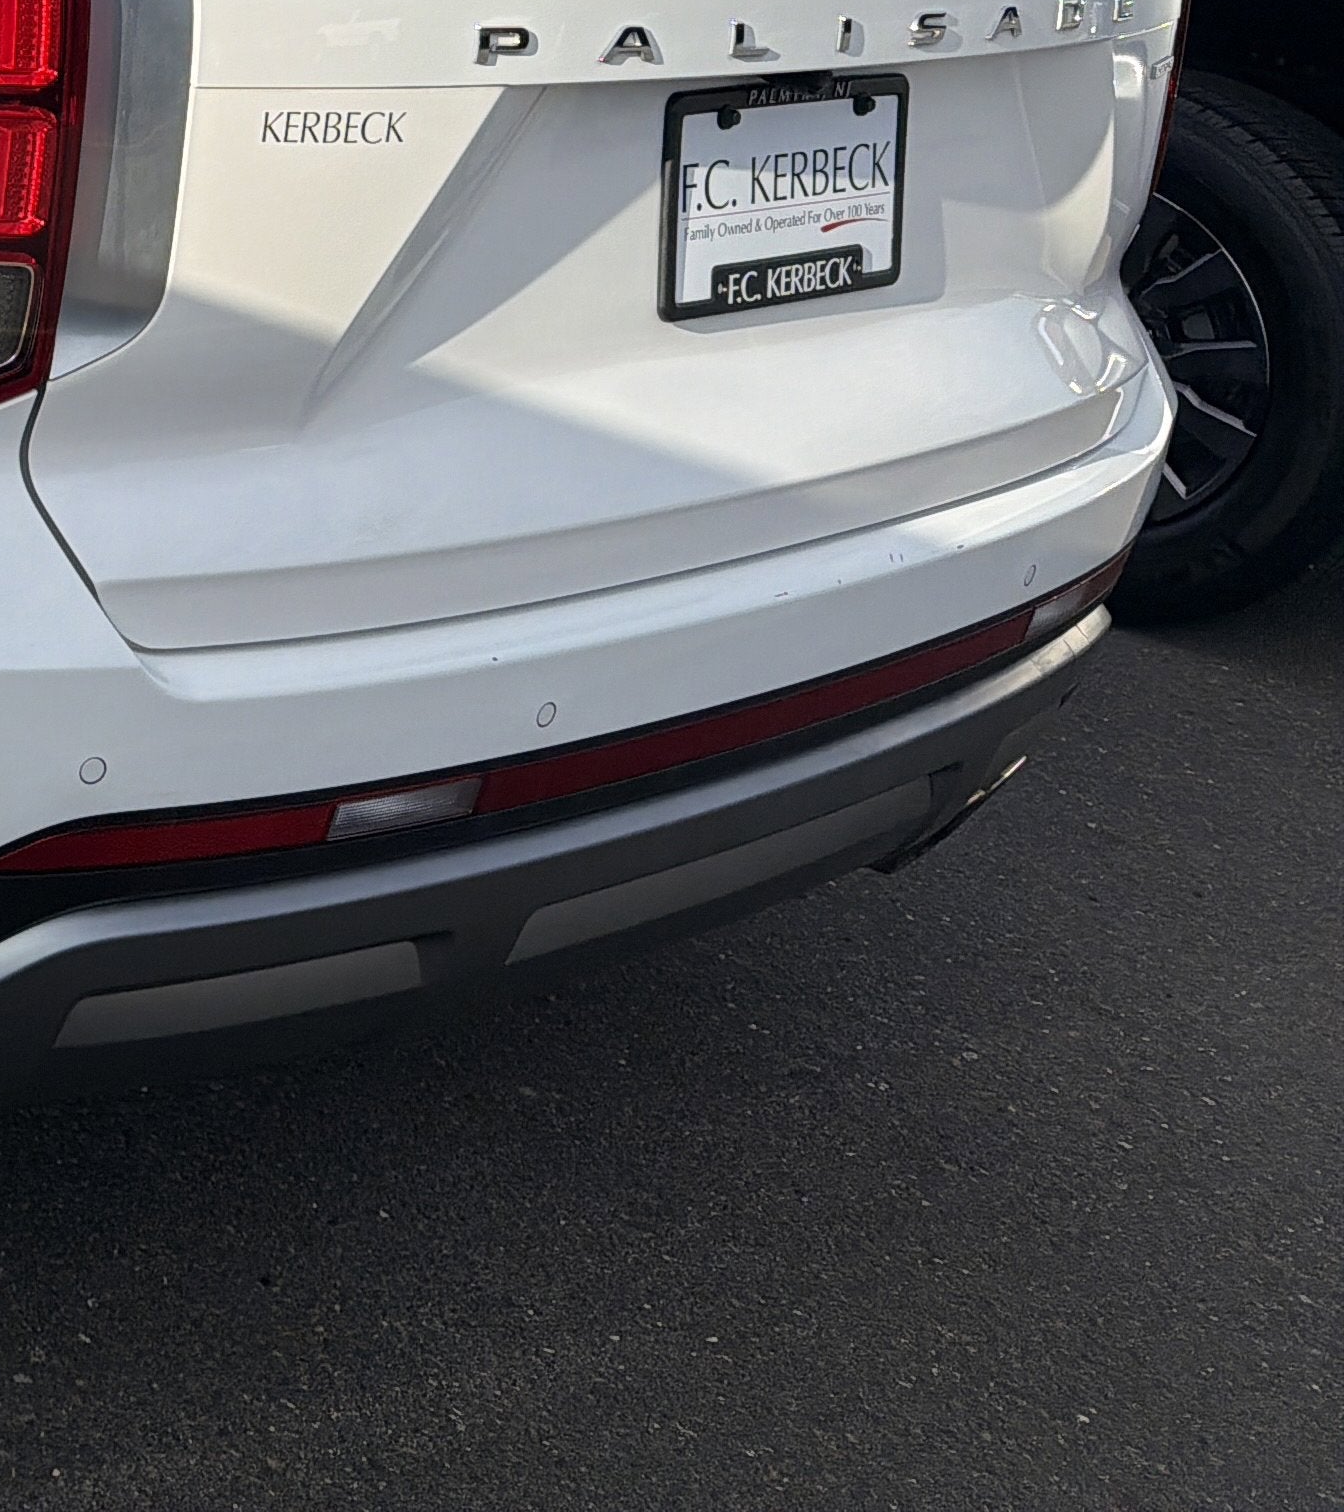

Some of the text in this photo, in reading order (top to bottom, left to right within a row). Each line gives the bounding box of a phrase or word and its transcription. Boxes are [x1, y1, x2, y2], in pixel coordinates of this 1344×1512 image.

[261, 111, 407, 144] KERBECK
[682, 140, 891, 213] F.C. KERBECK
[683, 201, 885, 242] Family Owned & Operated For Over 100 Years
[727, 256, 853, 304] F.C. KERBECK
